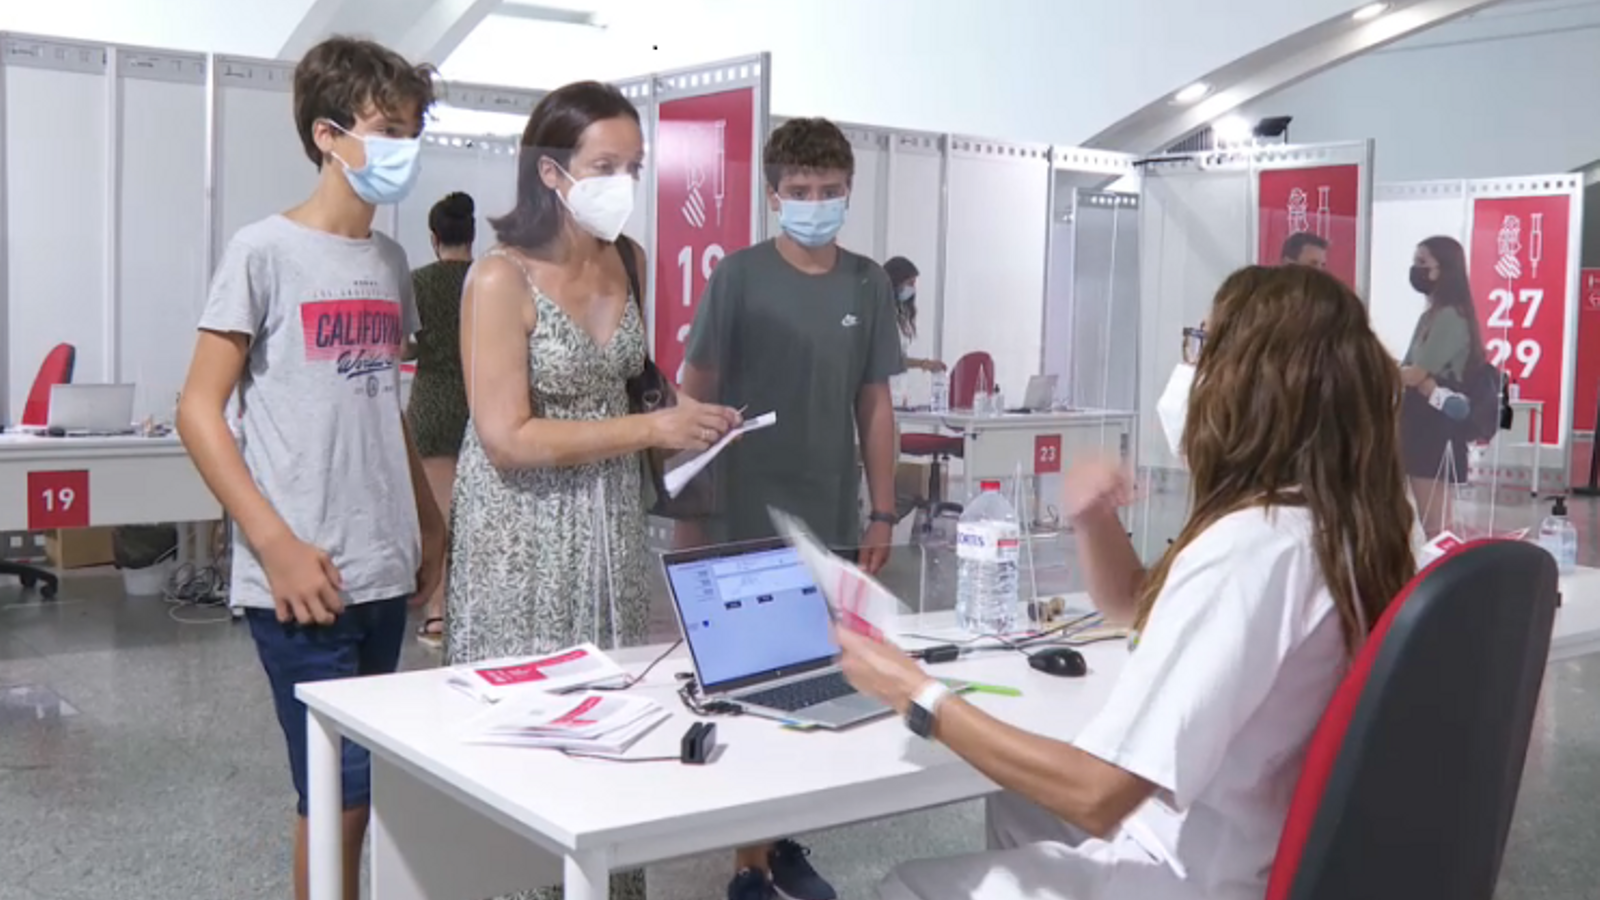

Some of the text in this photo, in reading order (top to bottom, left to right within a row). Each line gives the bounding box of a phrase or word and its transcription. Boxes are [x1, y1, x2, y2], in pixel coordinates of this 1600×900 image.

[1486, 288, 1544, 329] 27
[1485, 338, 1542, 379] 29
[41, 488, 76, 512] 19
